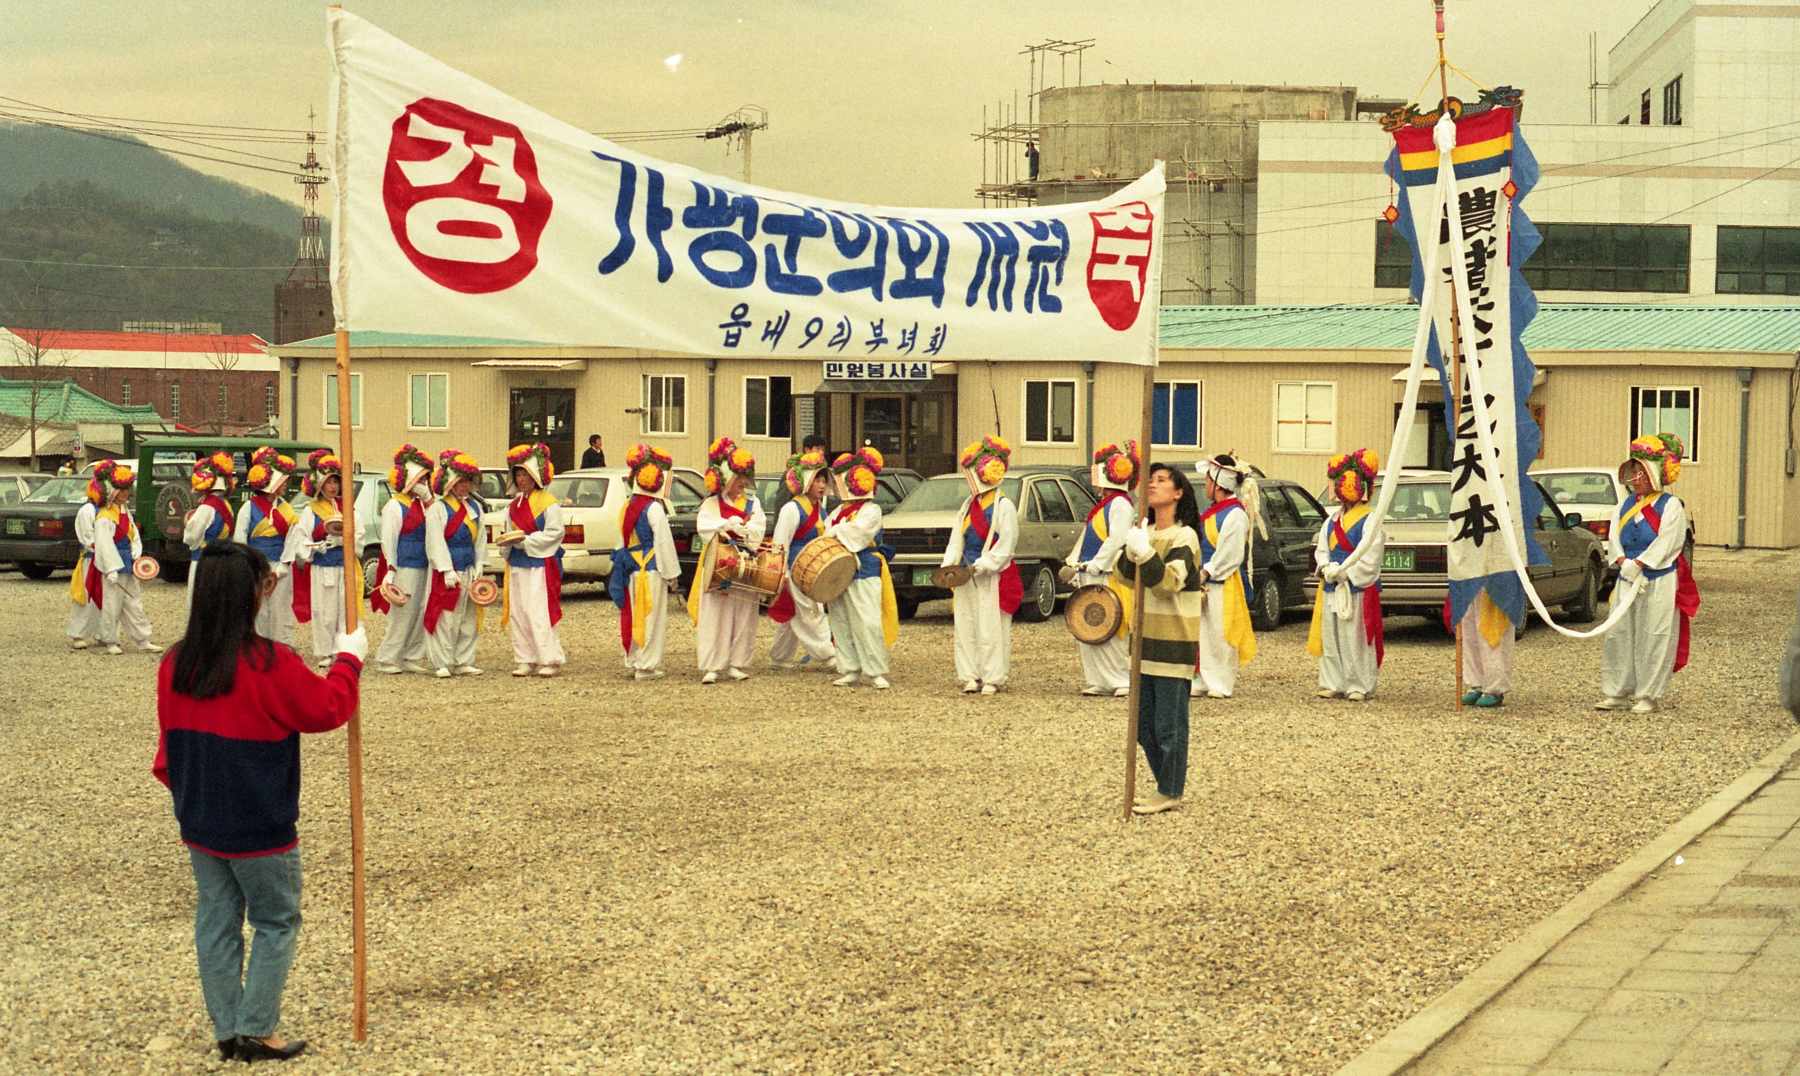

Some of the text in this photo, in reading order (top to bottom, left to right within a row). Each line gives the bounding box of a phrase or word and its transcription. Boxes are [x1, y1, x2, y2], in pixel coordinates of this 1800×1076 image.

[394, 110, 529, 266] 경
[1091, 202, 1151, 304] 축
[826, 362, 928, 378] 민원봉사실
